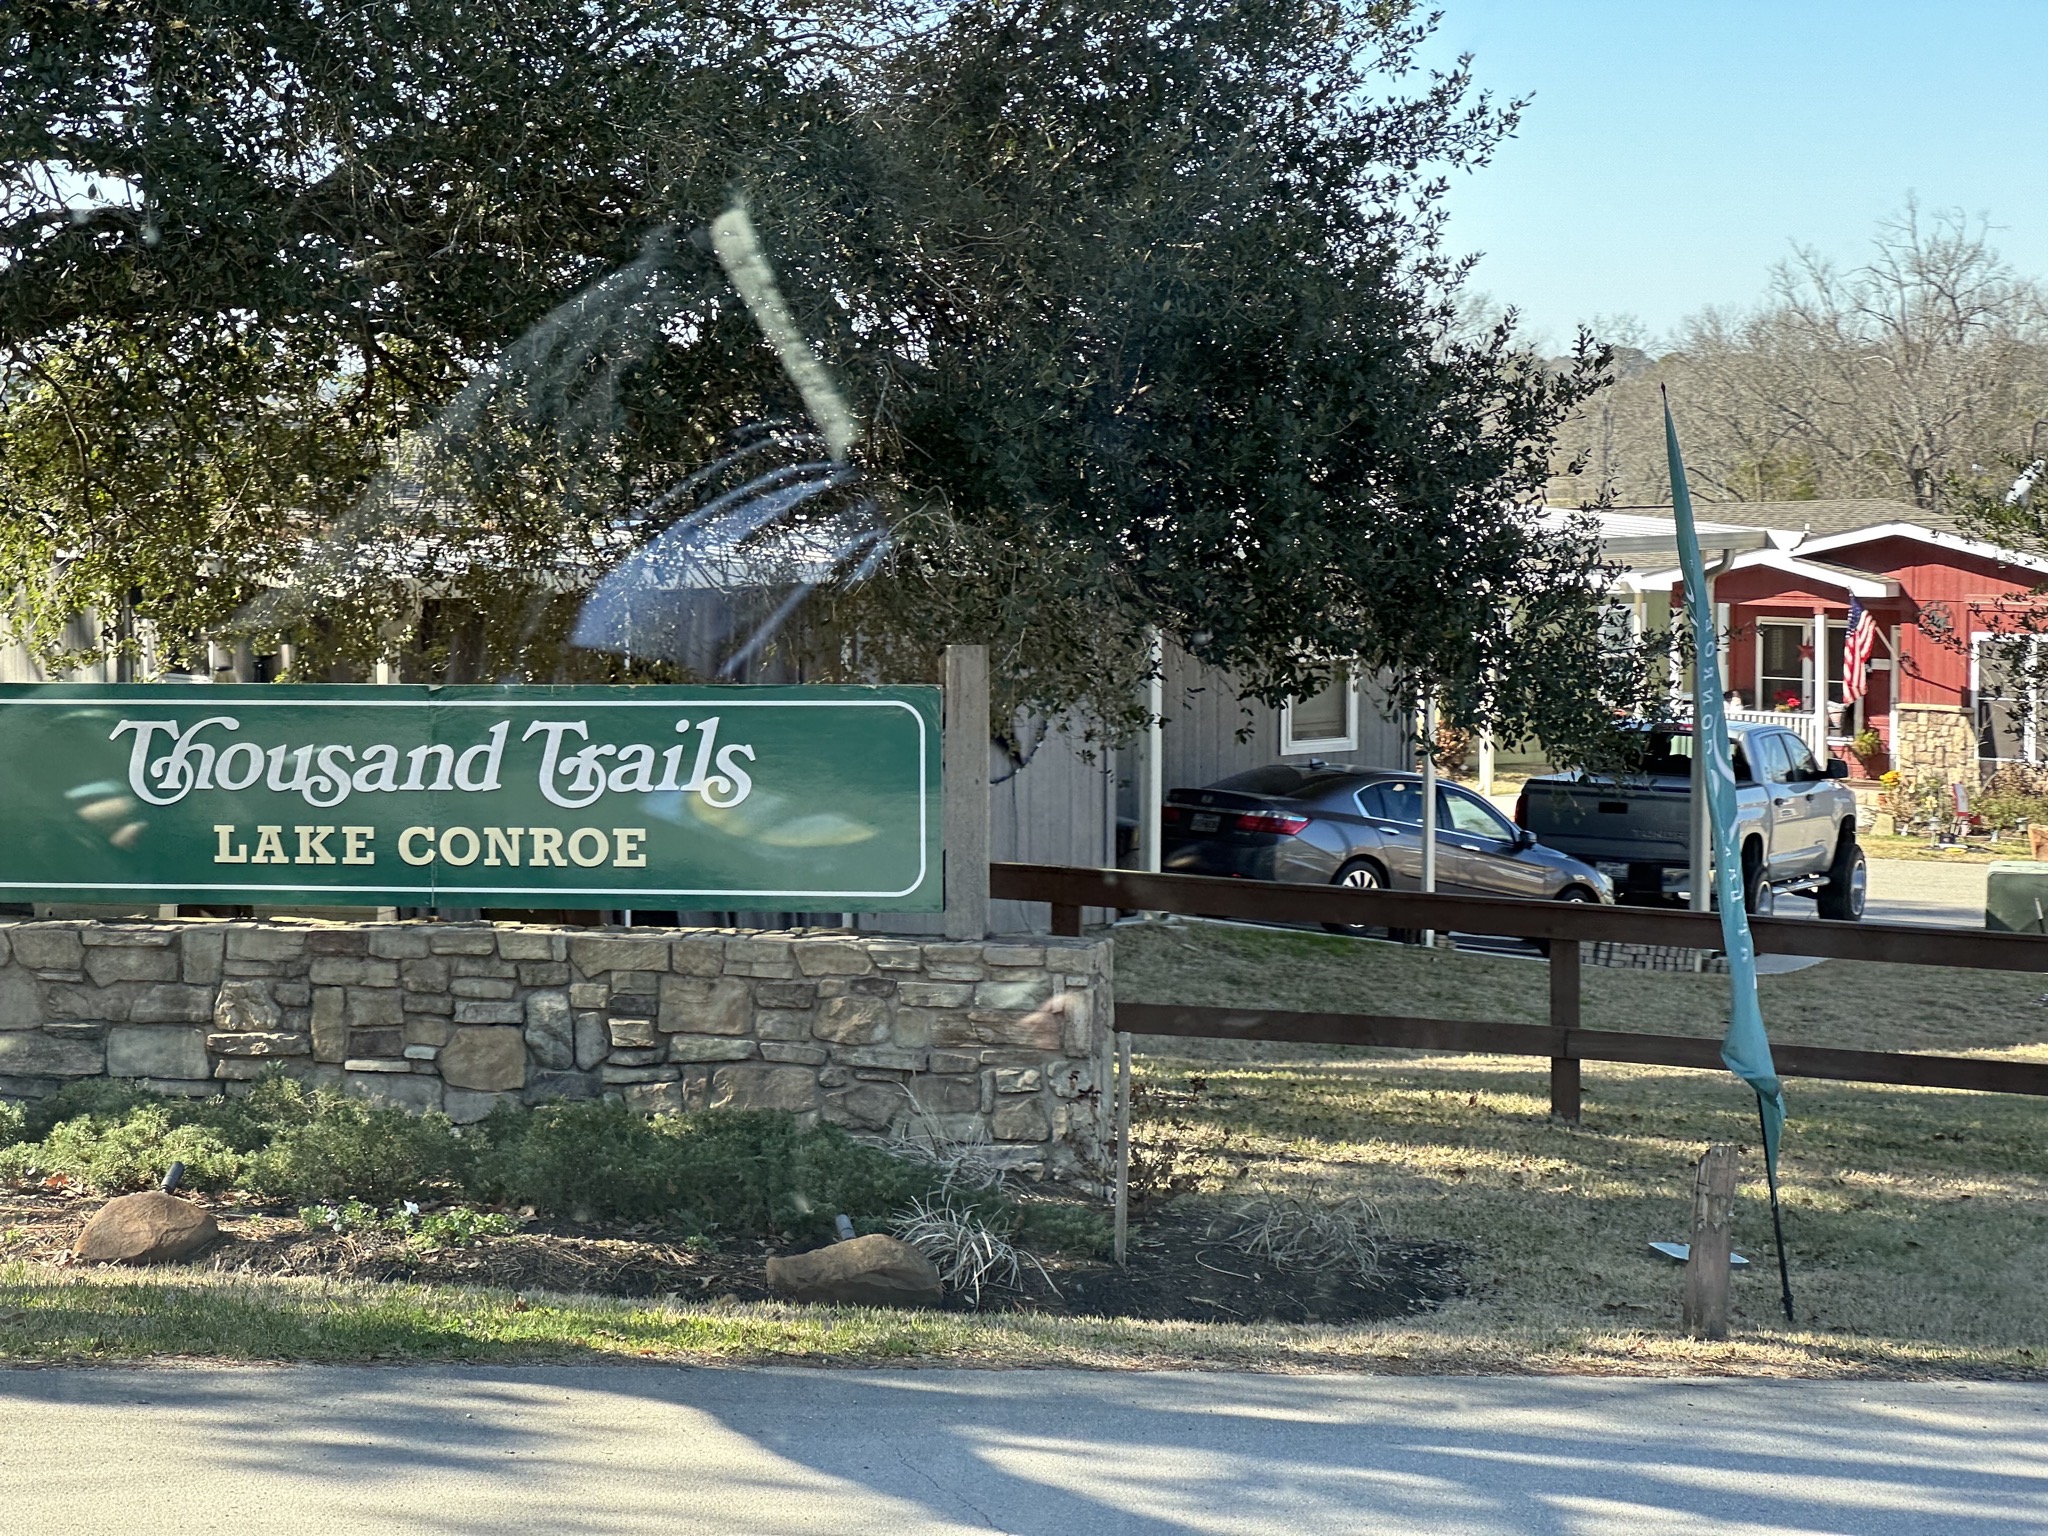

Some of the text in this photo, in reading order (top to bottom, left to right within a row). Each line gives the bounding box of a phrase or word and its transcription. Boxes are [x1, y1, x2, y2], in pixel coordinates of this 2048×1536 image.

[109, 716, 756, 809] Thousand Trails
[213, 825, 647, 867] LAKE CONROE
